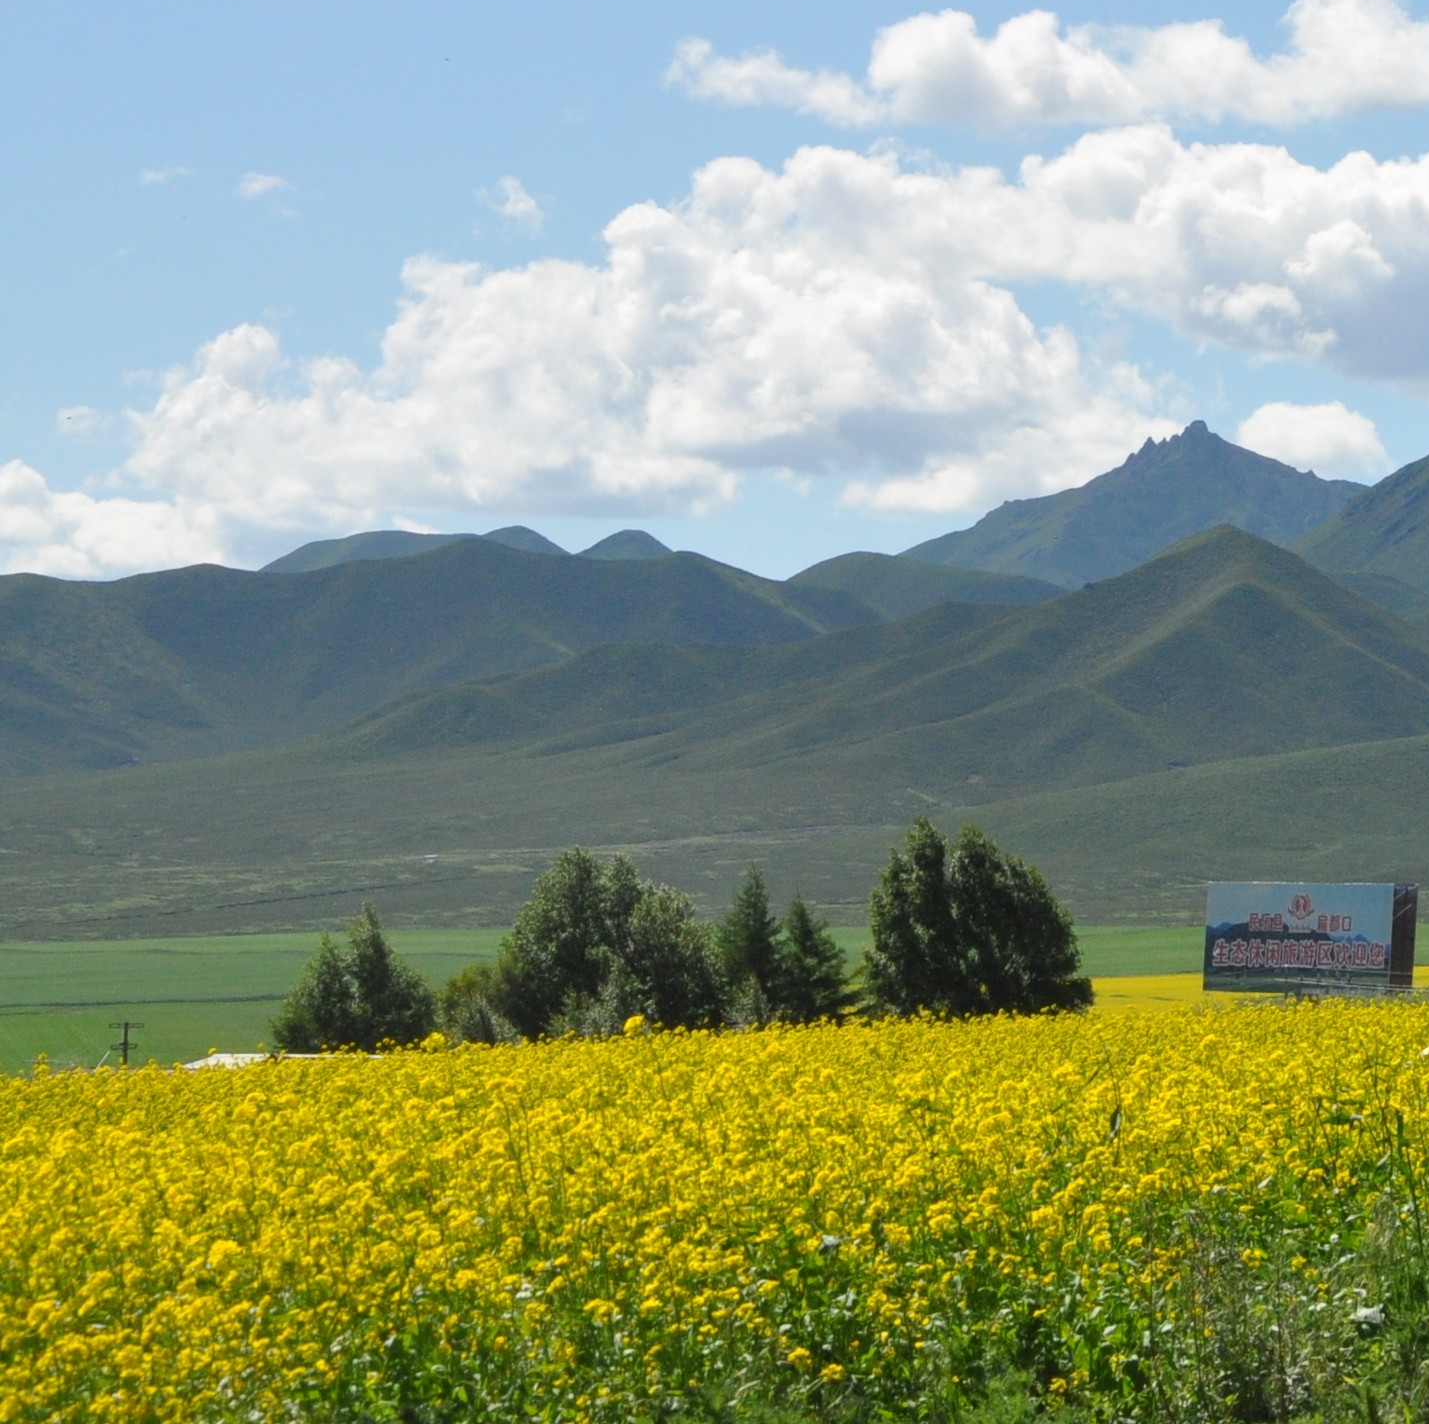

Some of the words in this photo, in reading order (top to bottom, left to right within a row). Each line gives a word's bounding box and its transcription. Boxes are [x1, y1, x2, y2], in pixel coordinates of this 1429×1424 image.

[1248, 912, 1284, 932] 民乐县
[1317, 914, 1352, 932] 扁都口
[1212, 938, 1385, 968] 生态休闲旅游区欢迎您
